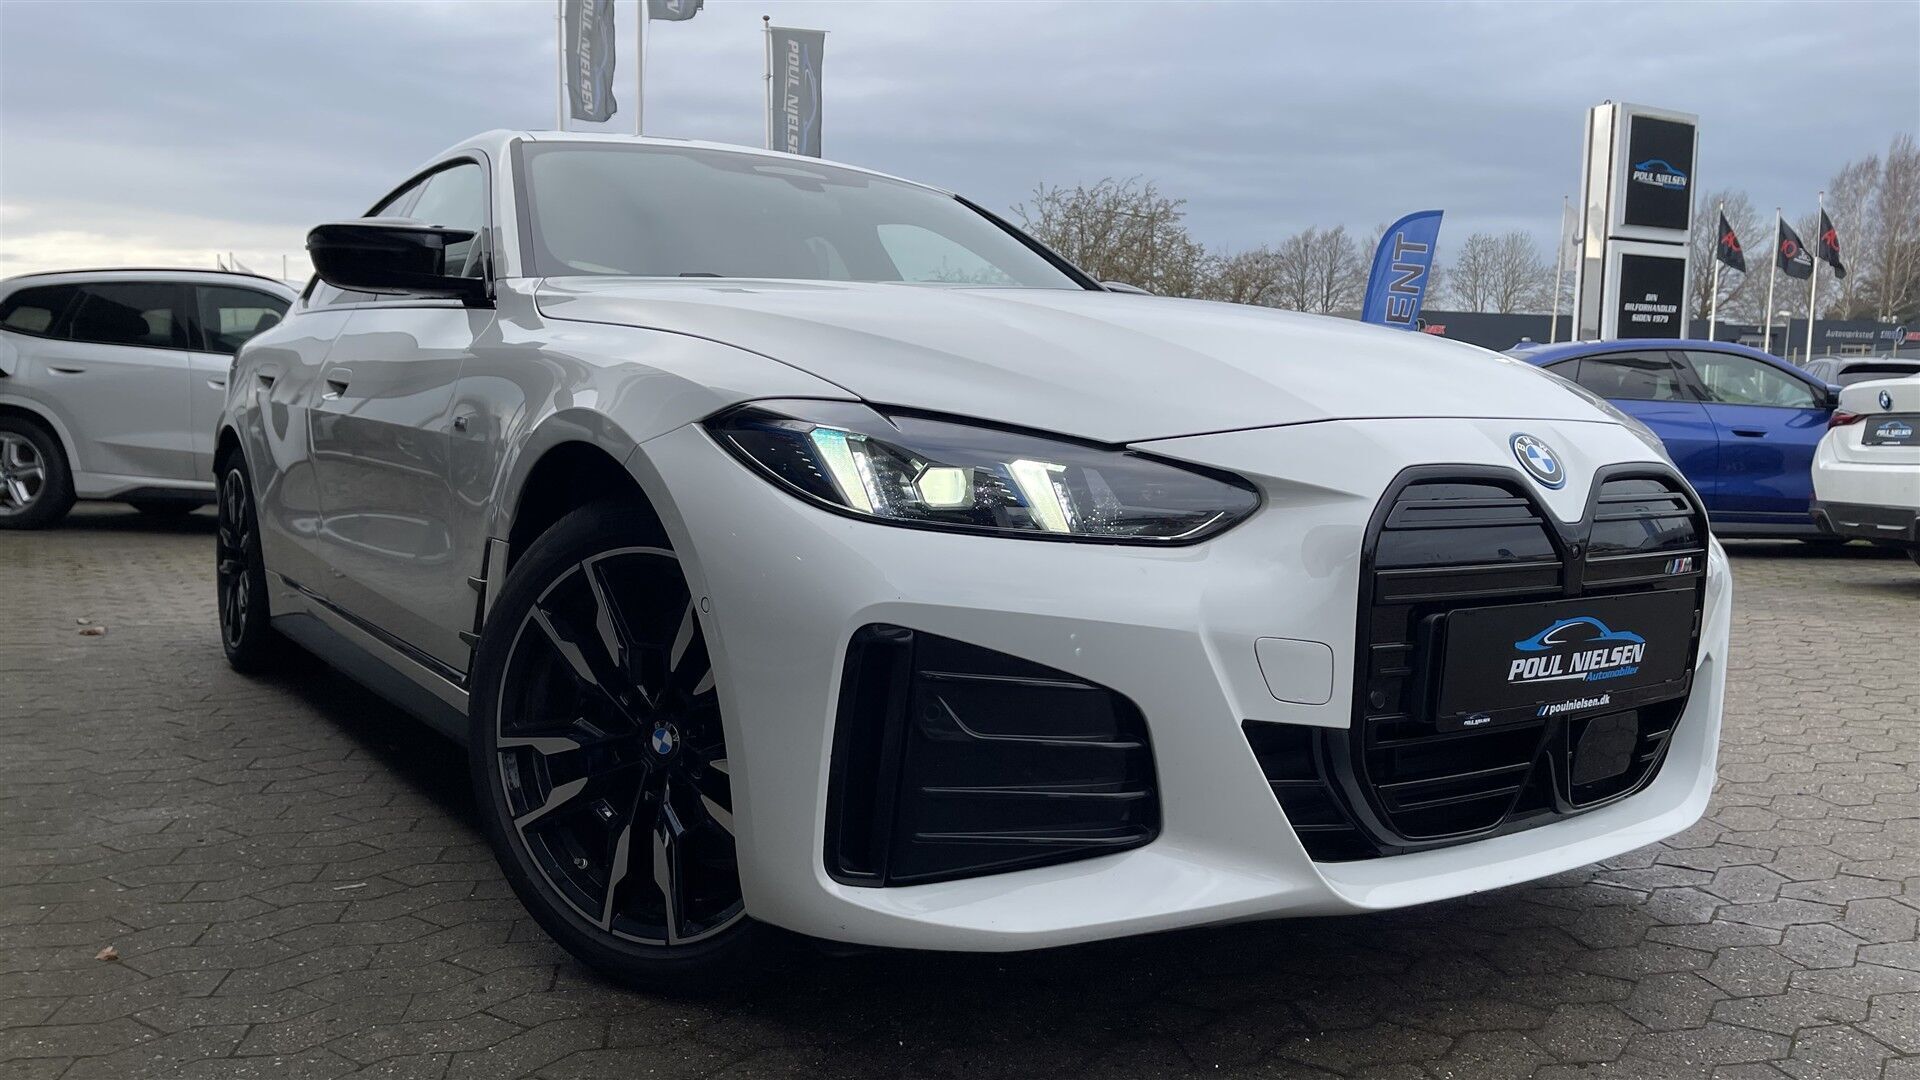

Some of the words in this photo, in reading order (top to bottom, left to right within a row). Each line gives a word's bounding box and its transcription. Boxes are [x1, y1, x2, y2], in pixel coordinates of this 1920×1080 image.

[580, 0, 593, 30] OUL
[787, 39, 800, 88] POUL
[580, 37, 594, 115] NIELSEN
[787, 93, 800, 155] NIELSE
[1632, 170, 1654, 182] POUL
[1655, 173, 1688, 186] NIELSEN
[1624, 302, 1678, 314] BILFORHANDLER
[1645, 293, 1659, 303] DIN
[1652, 314, 1670, 325] 1979
[1507, 654, 1563, 681] POUL
[1569, 643, 1646, 672] NIELSEN
[1585, 665, 1639, 683] Automobiler
[1549, 694, 1611, 716] poulnielsen.dk
